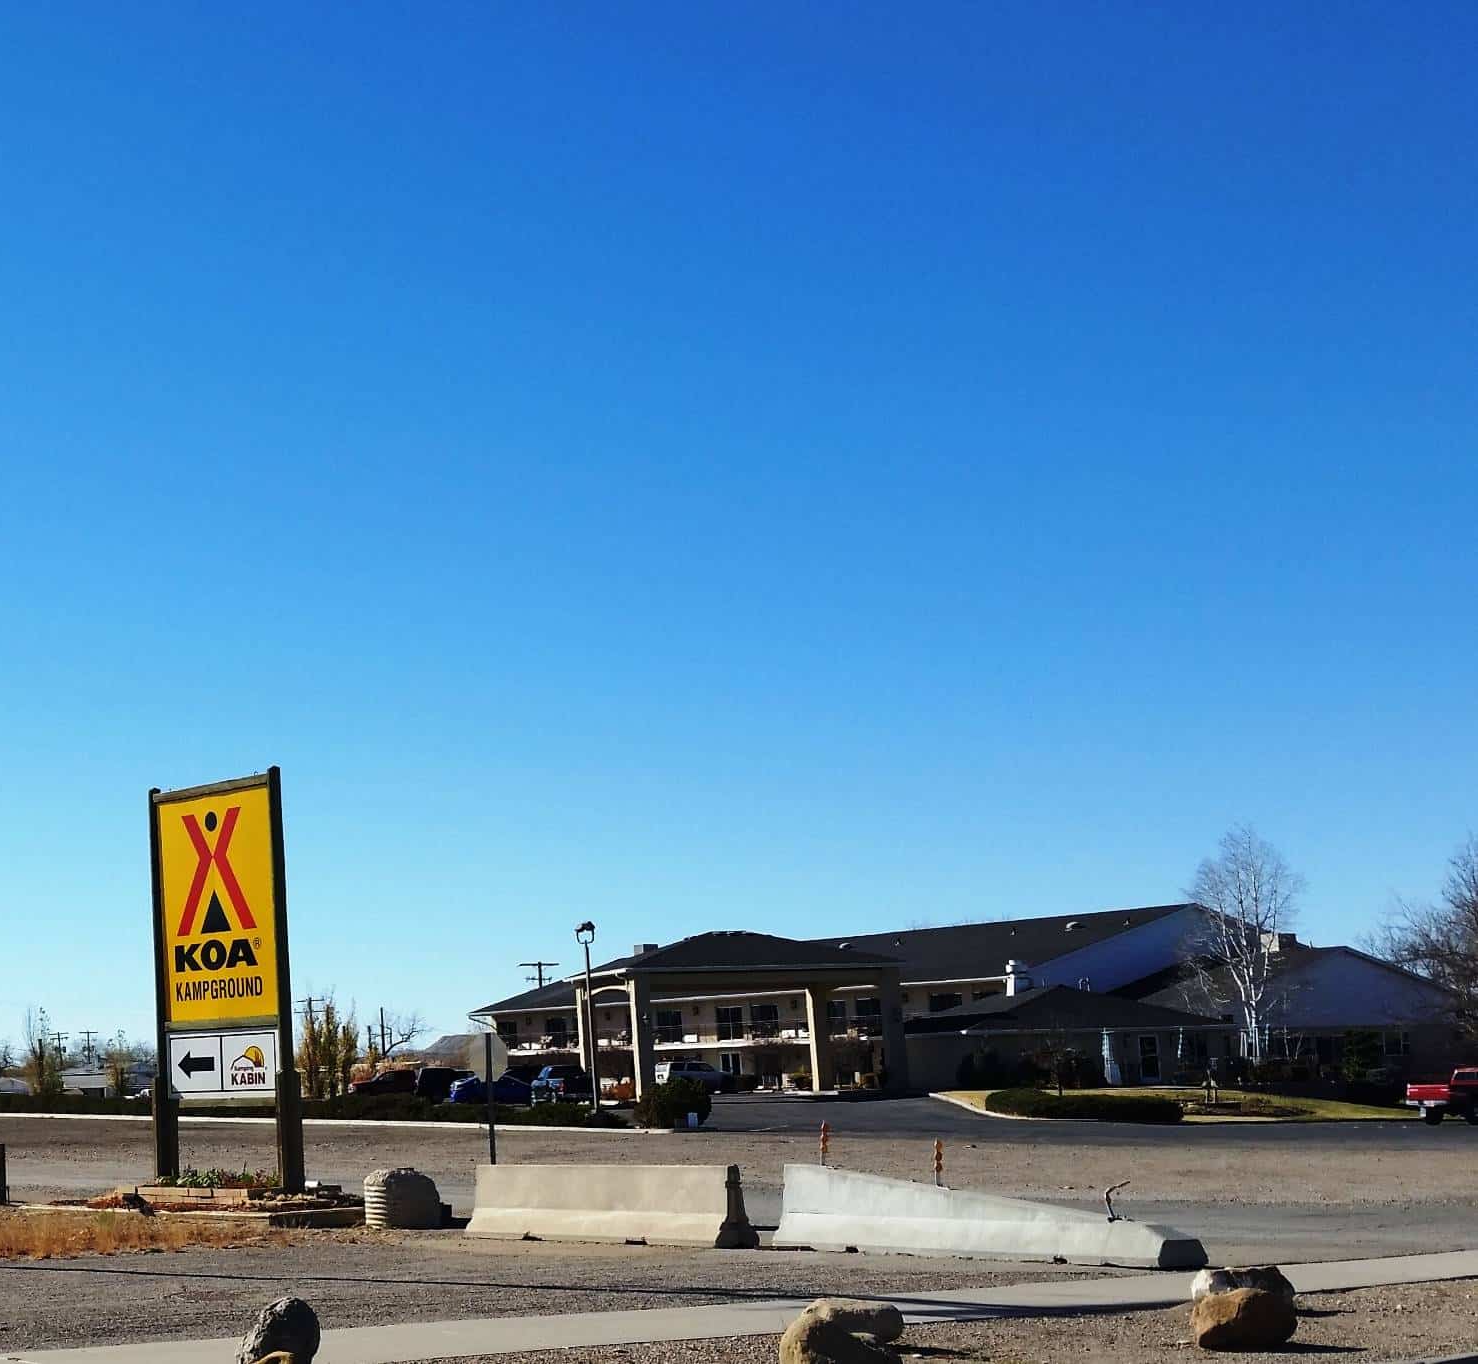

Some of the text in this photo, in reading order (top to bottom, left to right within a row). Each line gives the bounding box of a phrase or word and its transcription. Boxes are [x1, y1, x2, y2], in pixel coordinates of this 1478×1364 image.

[175, 939, 259, 973] KOA
[176, 976, 263, 1002] KAMPGROUND
[231, 1071, 266, 1085] KABIN
